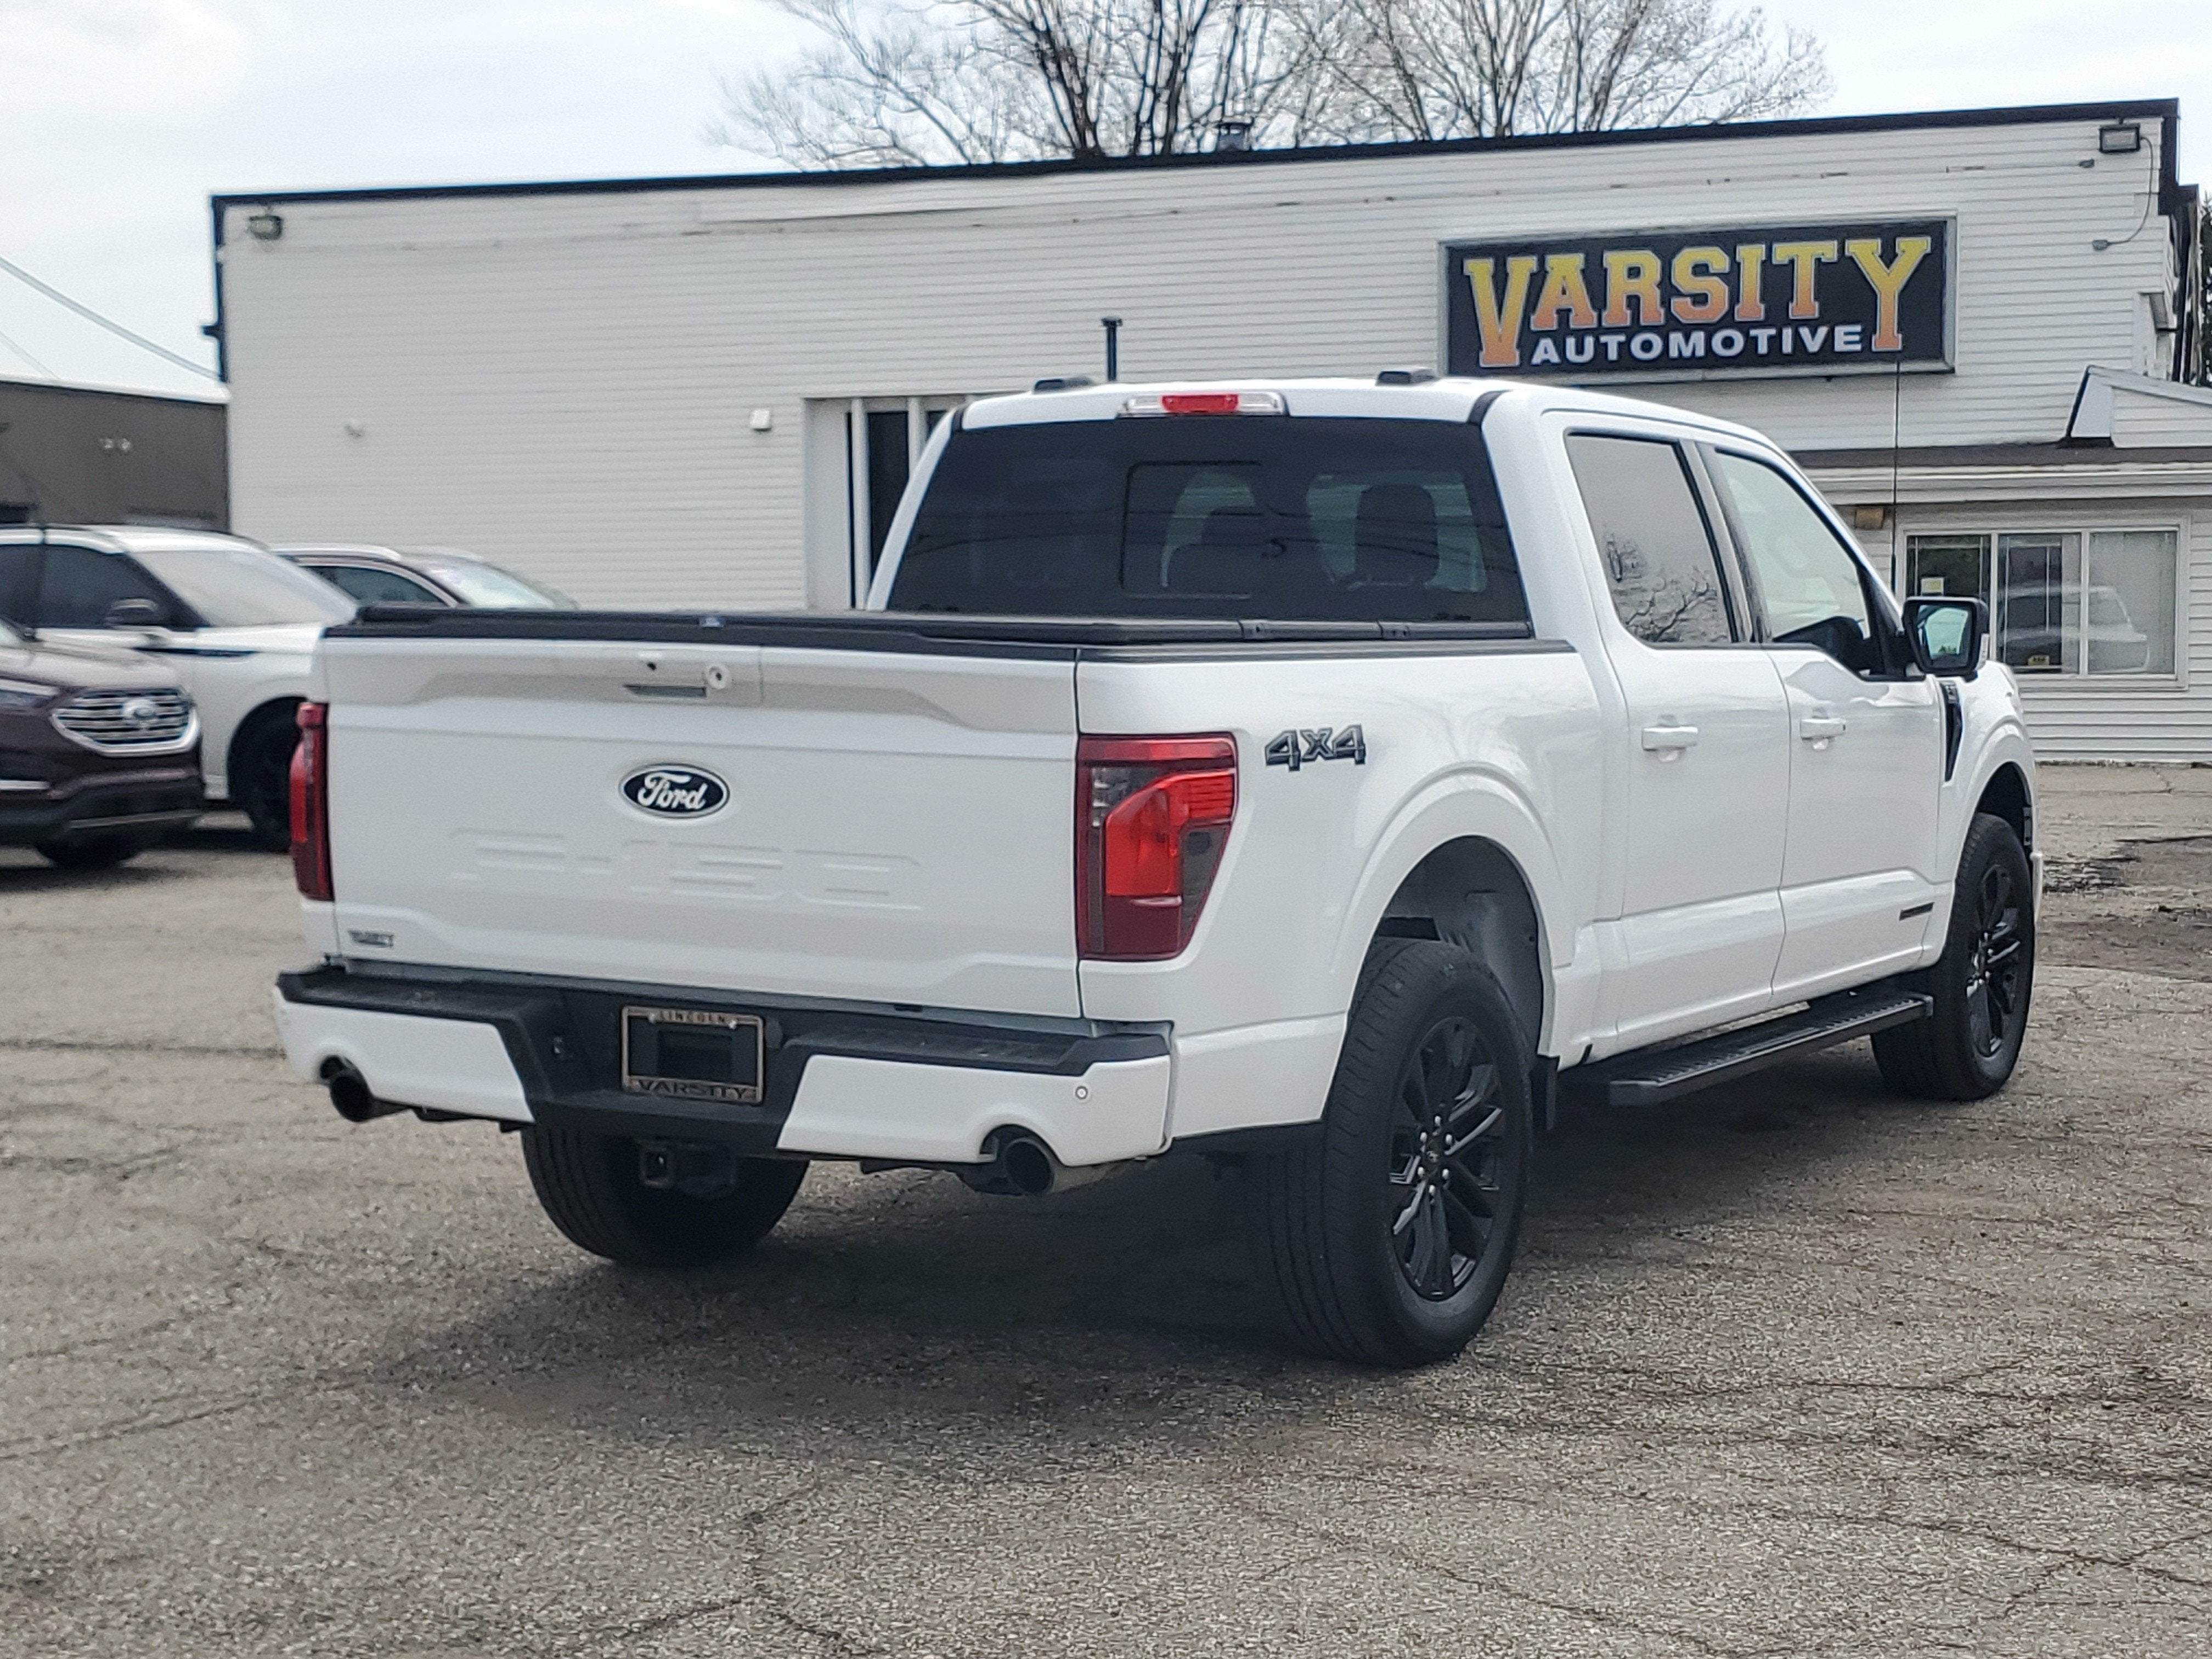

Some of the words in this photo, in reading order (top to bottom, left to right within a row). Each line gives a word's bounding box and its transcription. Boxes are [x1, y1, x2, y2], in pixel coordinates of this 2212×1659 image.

[1463, 236, 1931, 368] VARSITY
[1531, 325, 1863, 365] AUTOMOTIVE
[637, 772, 708, 809] Ford
[639, 1079, 747, 1099] VARSITY
